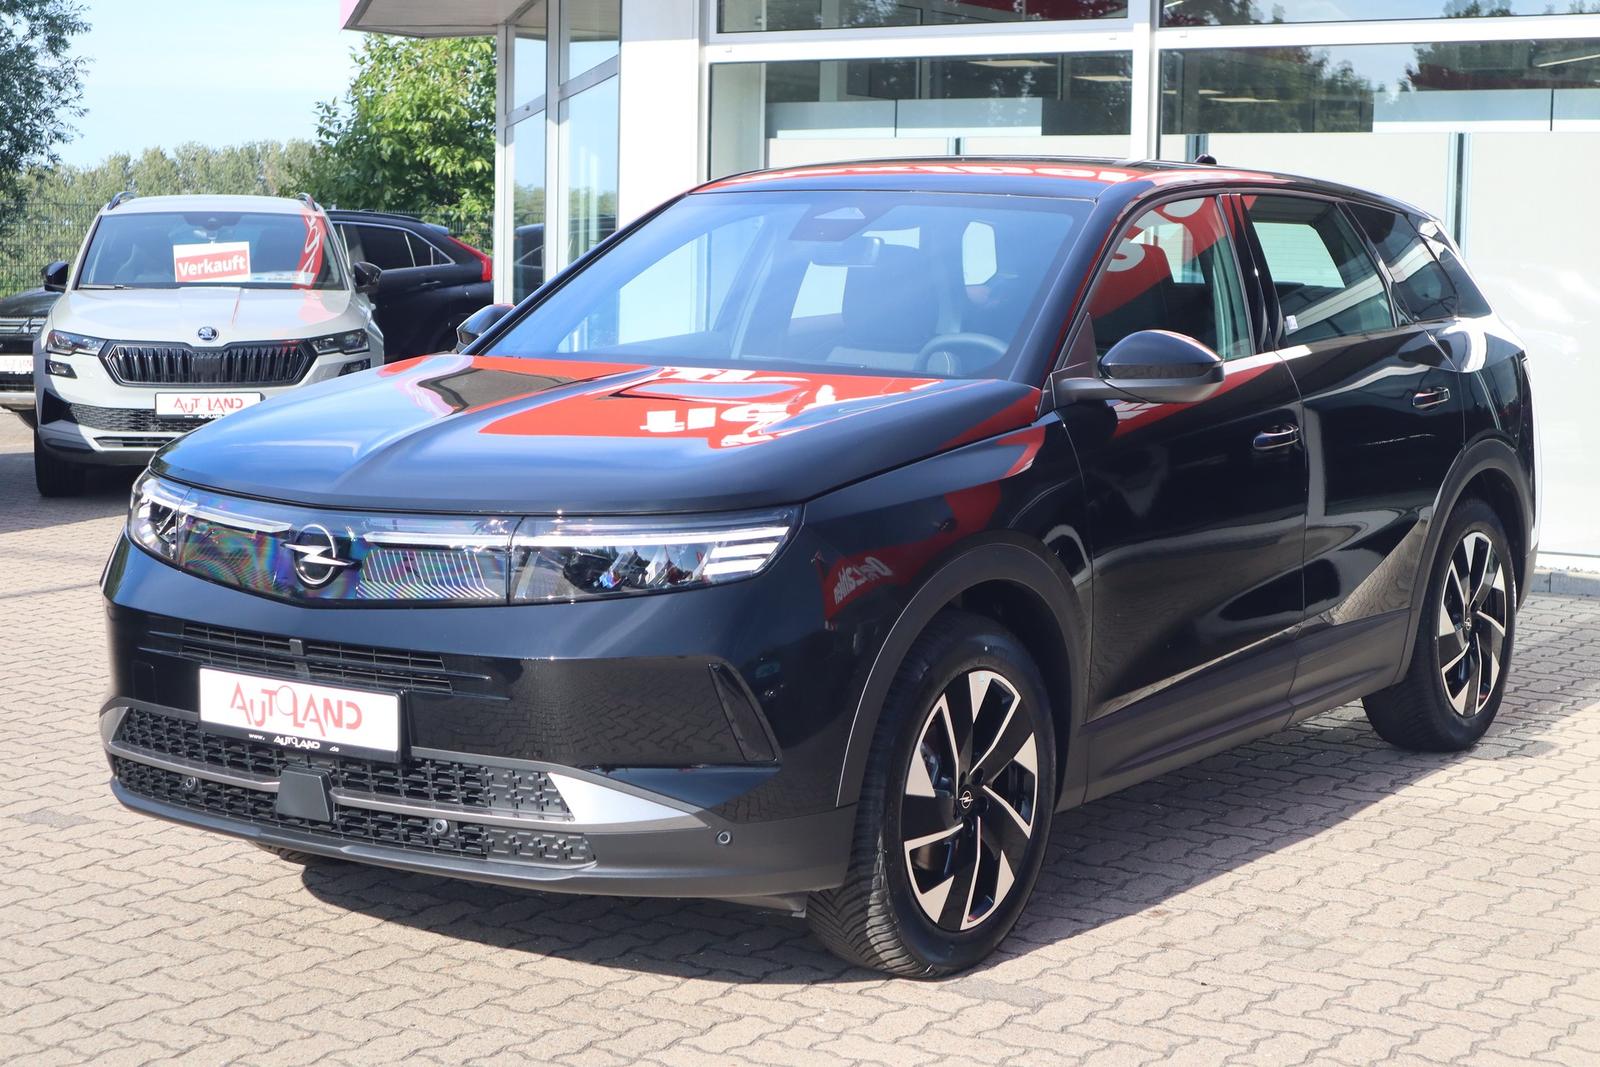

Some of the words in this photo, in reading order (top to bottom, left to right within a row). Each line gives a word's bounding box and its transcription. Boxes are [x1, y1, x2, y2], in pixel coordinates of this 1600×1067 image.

[178, 255, 246, 277] Verkauft
[174, 397, 244, 413] AUTLAND
[230, 682, 362, 737] AUTOLAND
[248, 733, 266, 741] www.
[274, 735, 321, 750] AUTOLAND
